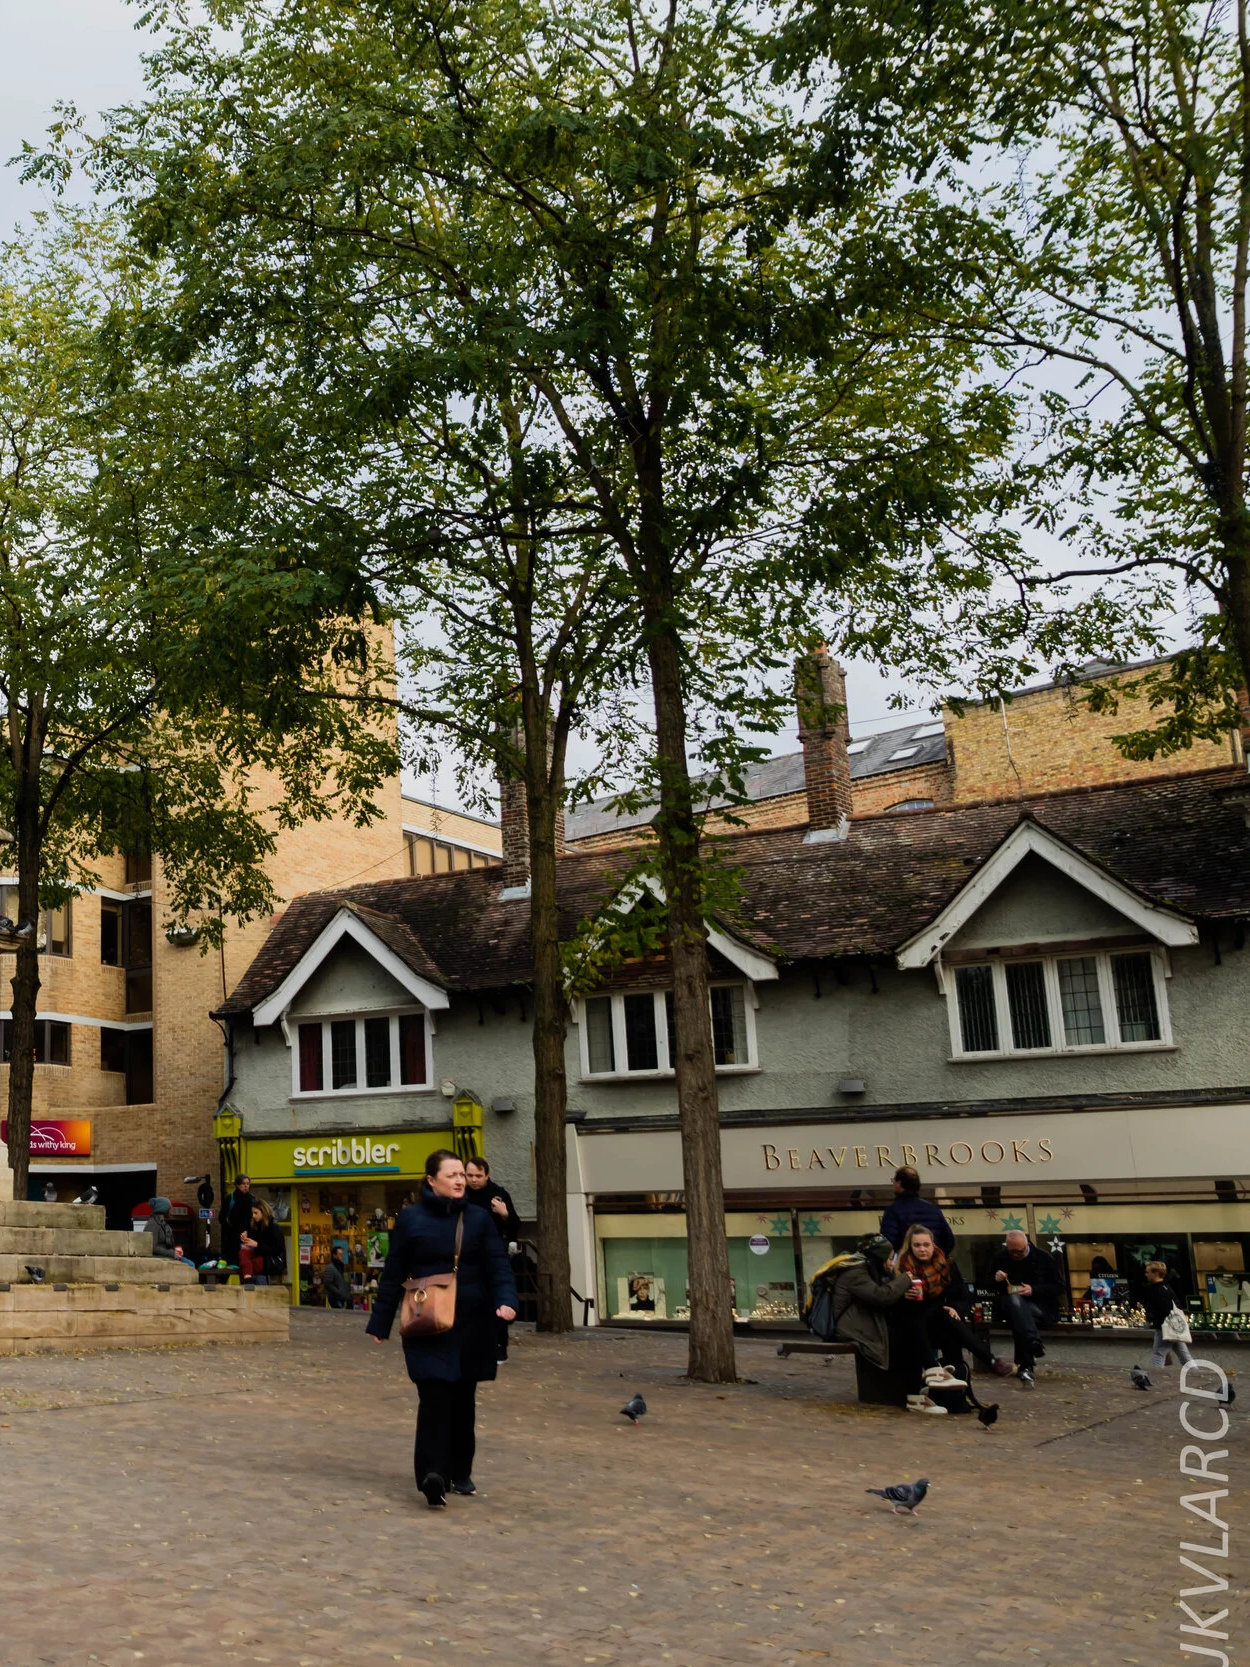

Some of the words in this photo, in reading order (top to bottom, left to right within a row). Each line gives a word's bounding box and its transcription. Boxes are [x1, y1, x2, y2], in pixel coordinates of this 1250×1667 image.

[38, 1140, 59, 1150] withy
[60, 1140, 76, 1150] king
[293, 1138, 400, 1168] scribbler
[760, 1138, 1053, 1171] BEAVERBROOKS
